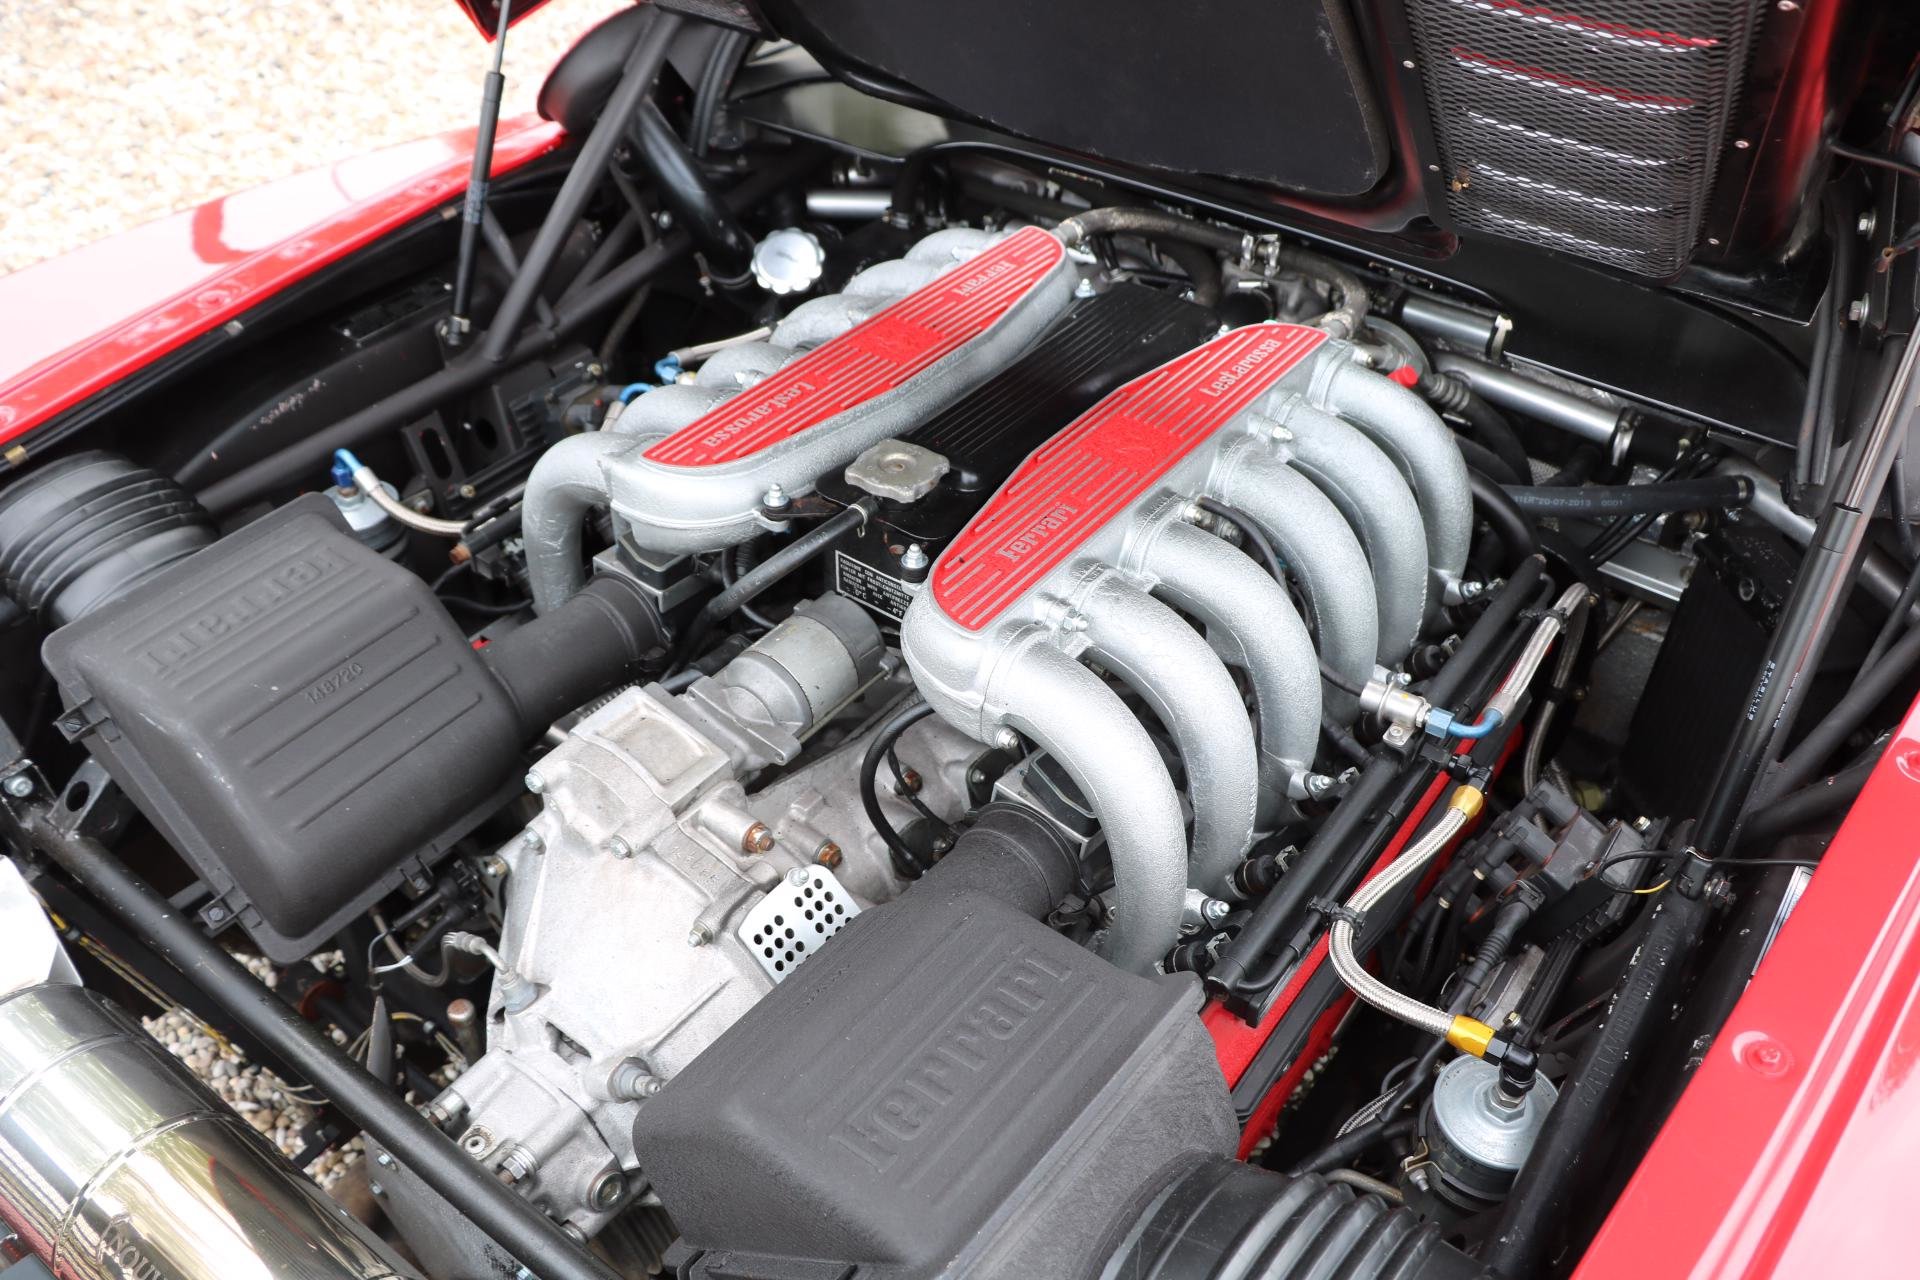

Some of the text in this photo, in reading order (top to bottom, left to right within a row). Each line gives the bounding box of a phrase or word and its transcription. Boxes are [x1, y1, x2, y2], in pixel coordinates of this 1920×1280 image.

[951, 260, 1017, 297] Ferrari
[995, 501, 1078, 563] Ferrari
[137, 547, 357, 680] Ferrari
[1748, 661, 1776, 721] STABILUS
[828, 944, 1074, 1173] Ferrari
